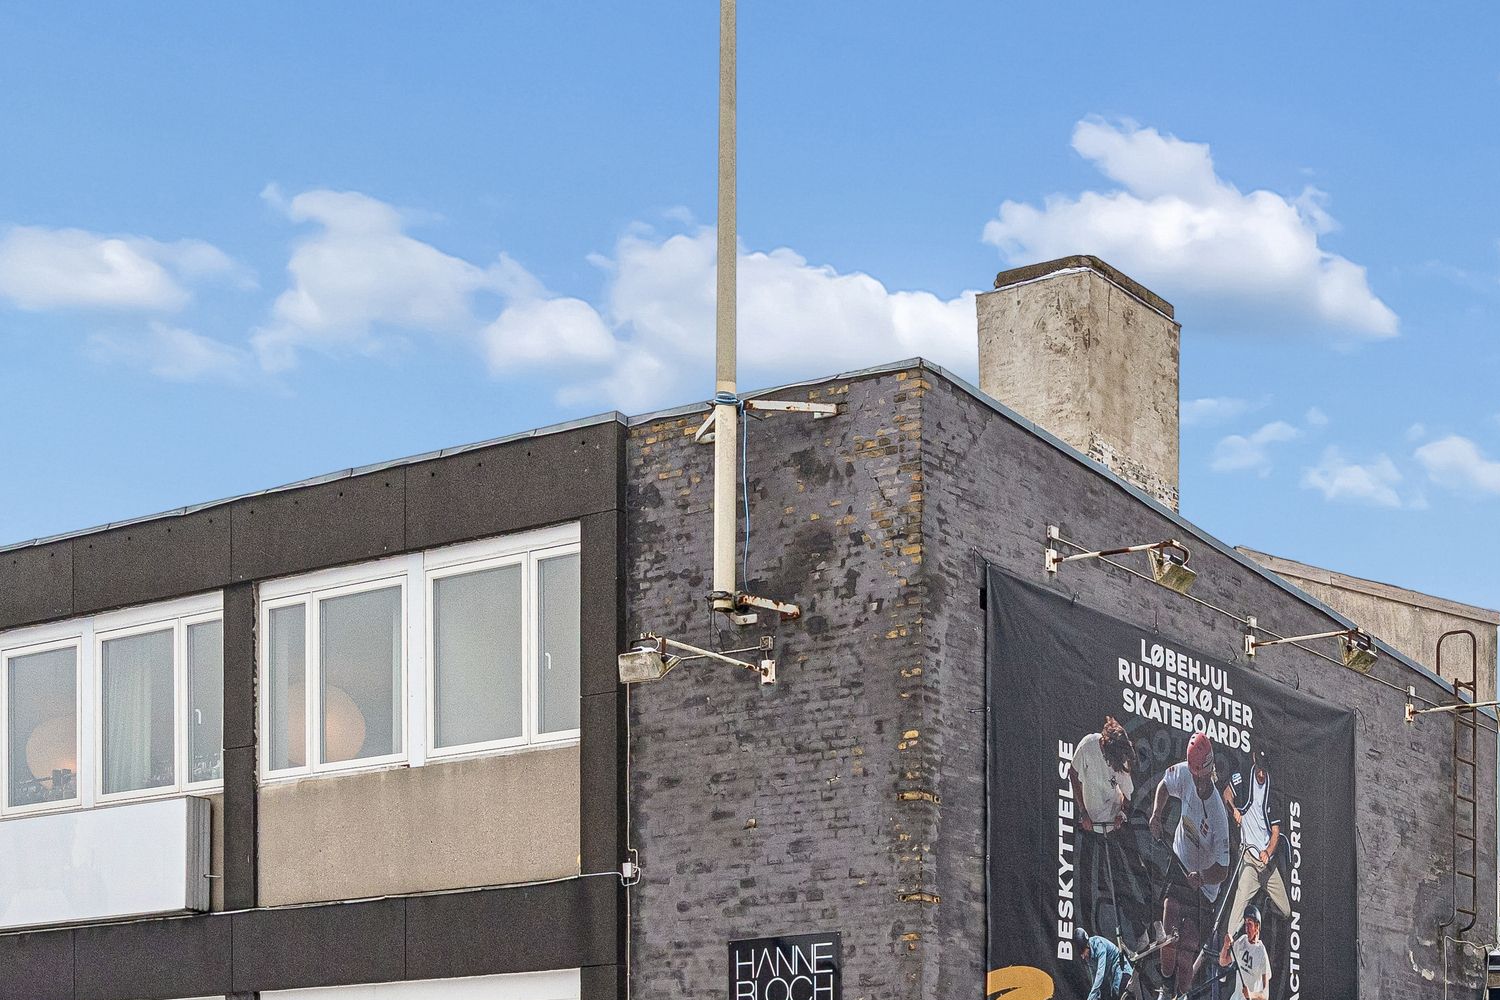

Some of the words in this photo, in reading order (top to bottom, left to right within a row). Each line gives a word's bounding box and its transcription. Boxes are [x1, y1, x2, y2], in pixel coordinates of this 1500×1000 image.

[1118, 657, 1254, 729] RULLESKØJTER
[1141, 638, 1233, 695] LØBEHJUL
[1122, 688, 1251, 753] SKATEBOARDS
[1057, 739, 1074, 961] BESKYTTELSE
[1289, 801, 1301, 903] SPORTS
[736, 942, 833, 979] HANNE
